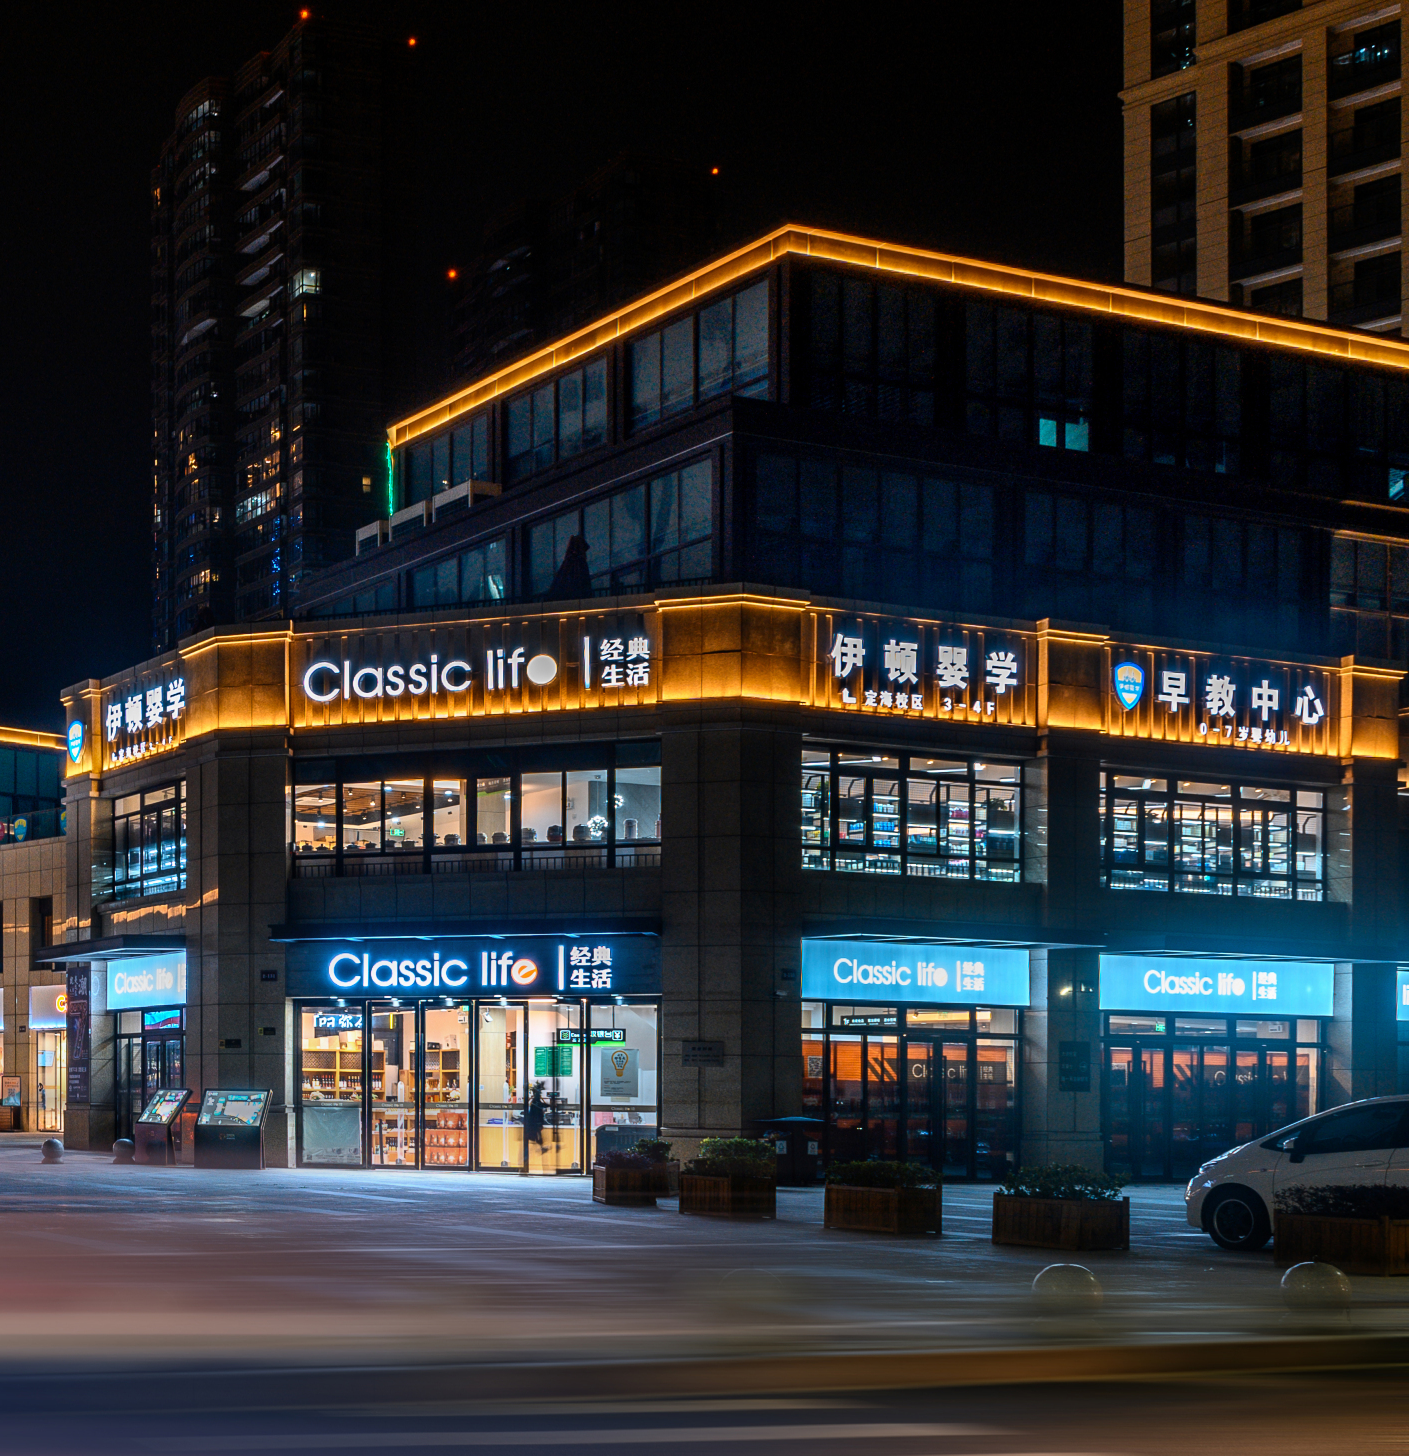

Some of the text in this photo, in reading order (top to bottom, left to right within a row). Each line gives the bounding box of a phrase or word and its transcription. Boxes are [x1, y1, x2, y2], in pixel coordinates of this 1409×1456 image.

[599, 637, 651, 661] 经典
[601, 663, 651, 687] 生活
[830, 633, 1018, 694] 伊顿婴学
[303, 654, 472, 702] Classic
[106, 677, 185, 741] 伊顿婴学
[864, 689, 924, 711] 定海校区
[1158, 671, 1324, 724] 早教中心
[328, 951, 538, 987] Classic life
[569, 946, 612, 966] 经典
[114, 970, 154, 995] Classic
[569, 968, 612, 988] 生活
[833, 957, 912, 986] Classic
[1144, 969, 1213, 996] Classic
